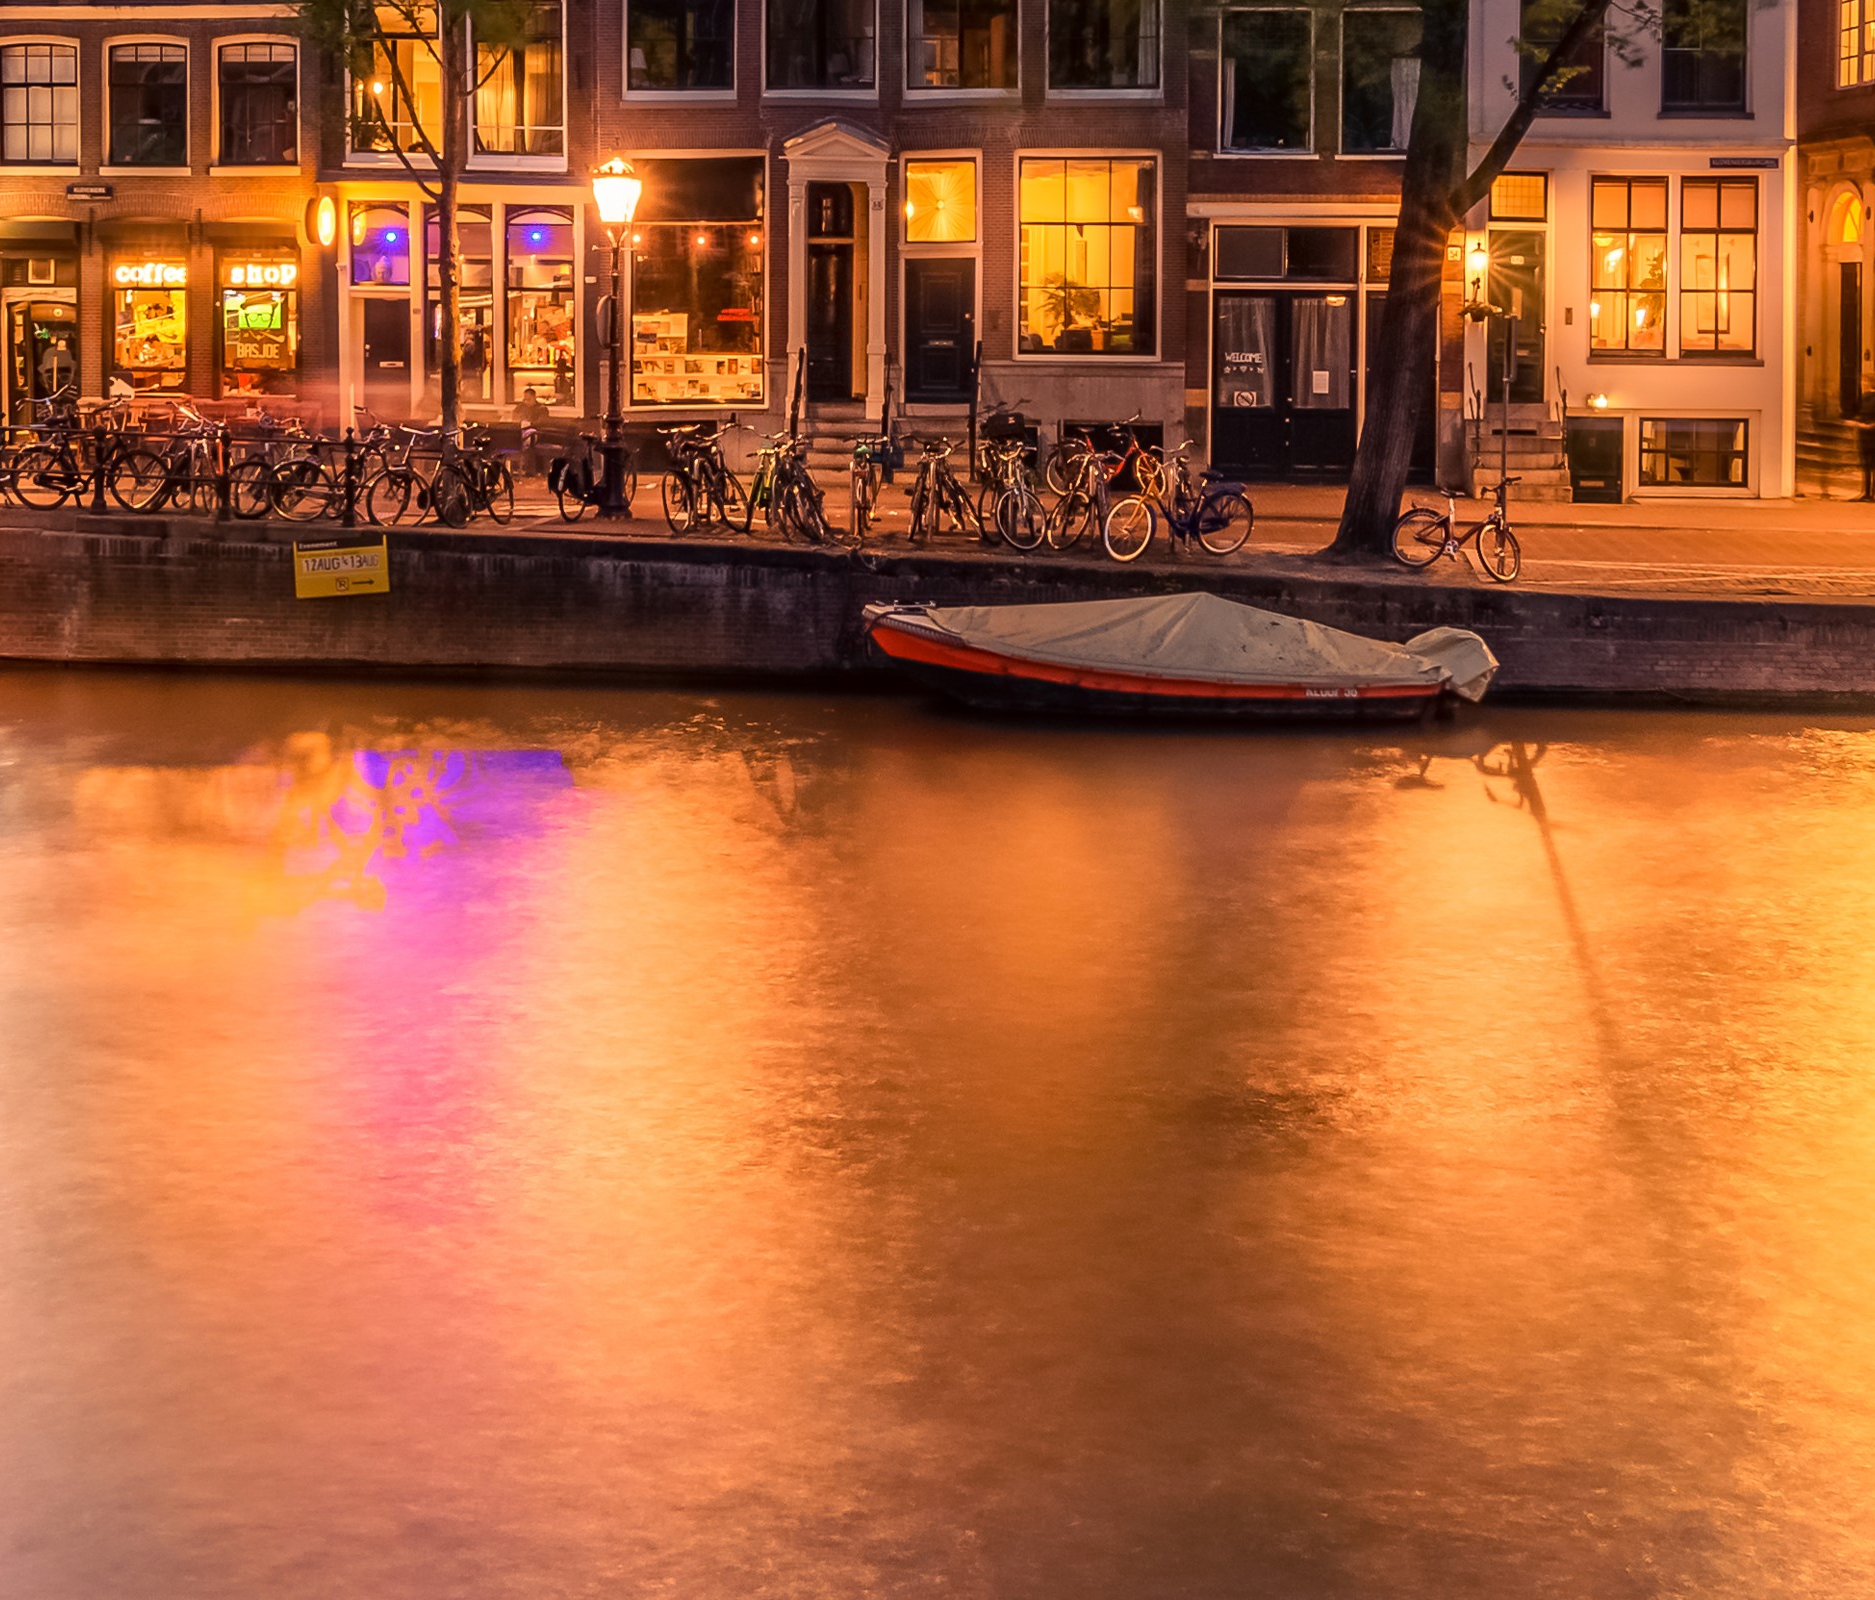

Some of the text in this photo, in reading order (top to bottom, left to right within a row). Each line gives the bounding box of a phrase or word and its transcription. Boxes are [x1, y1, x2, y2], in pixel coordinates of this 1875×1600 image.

[115, 263, 297, 285] coffee shop
[1224, 352, 1263, 364] WELCOME
